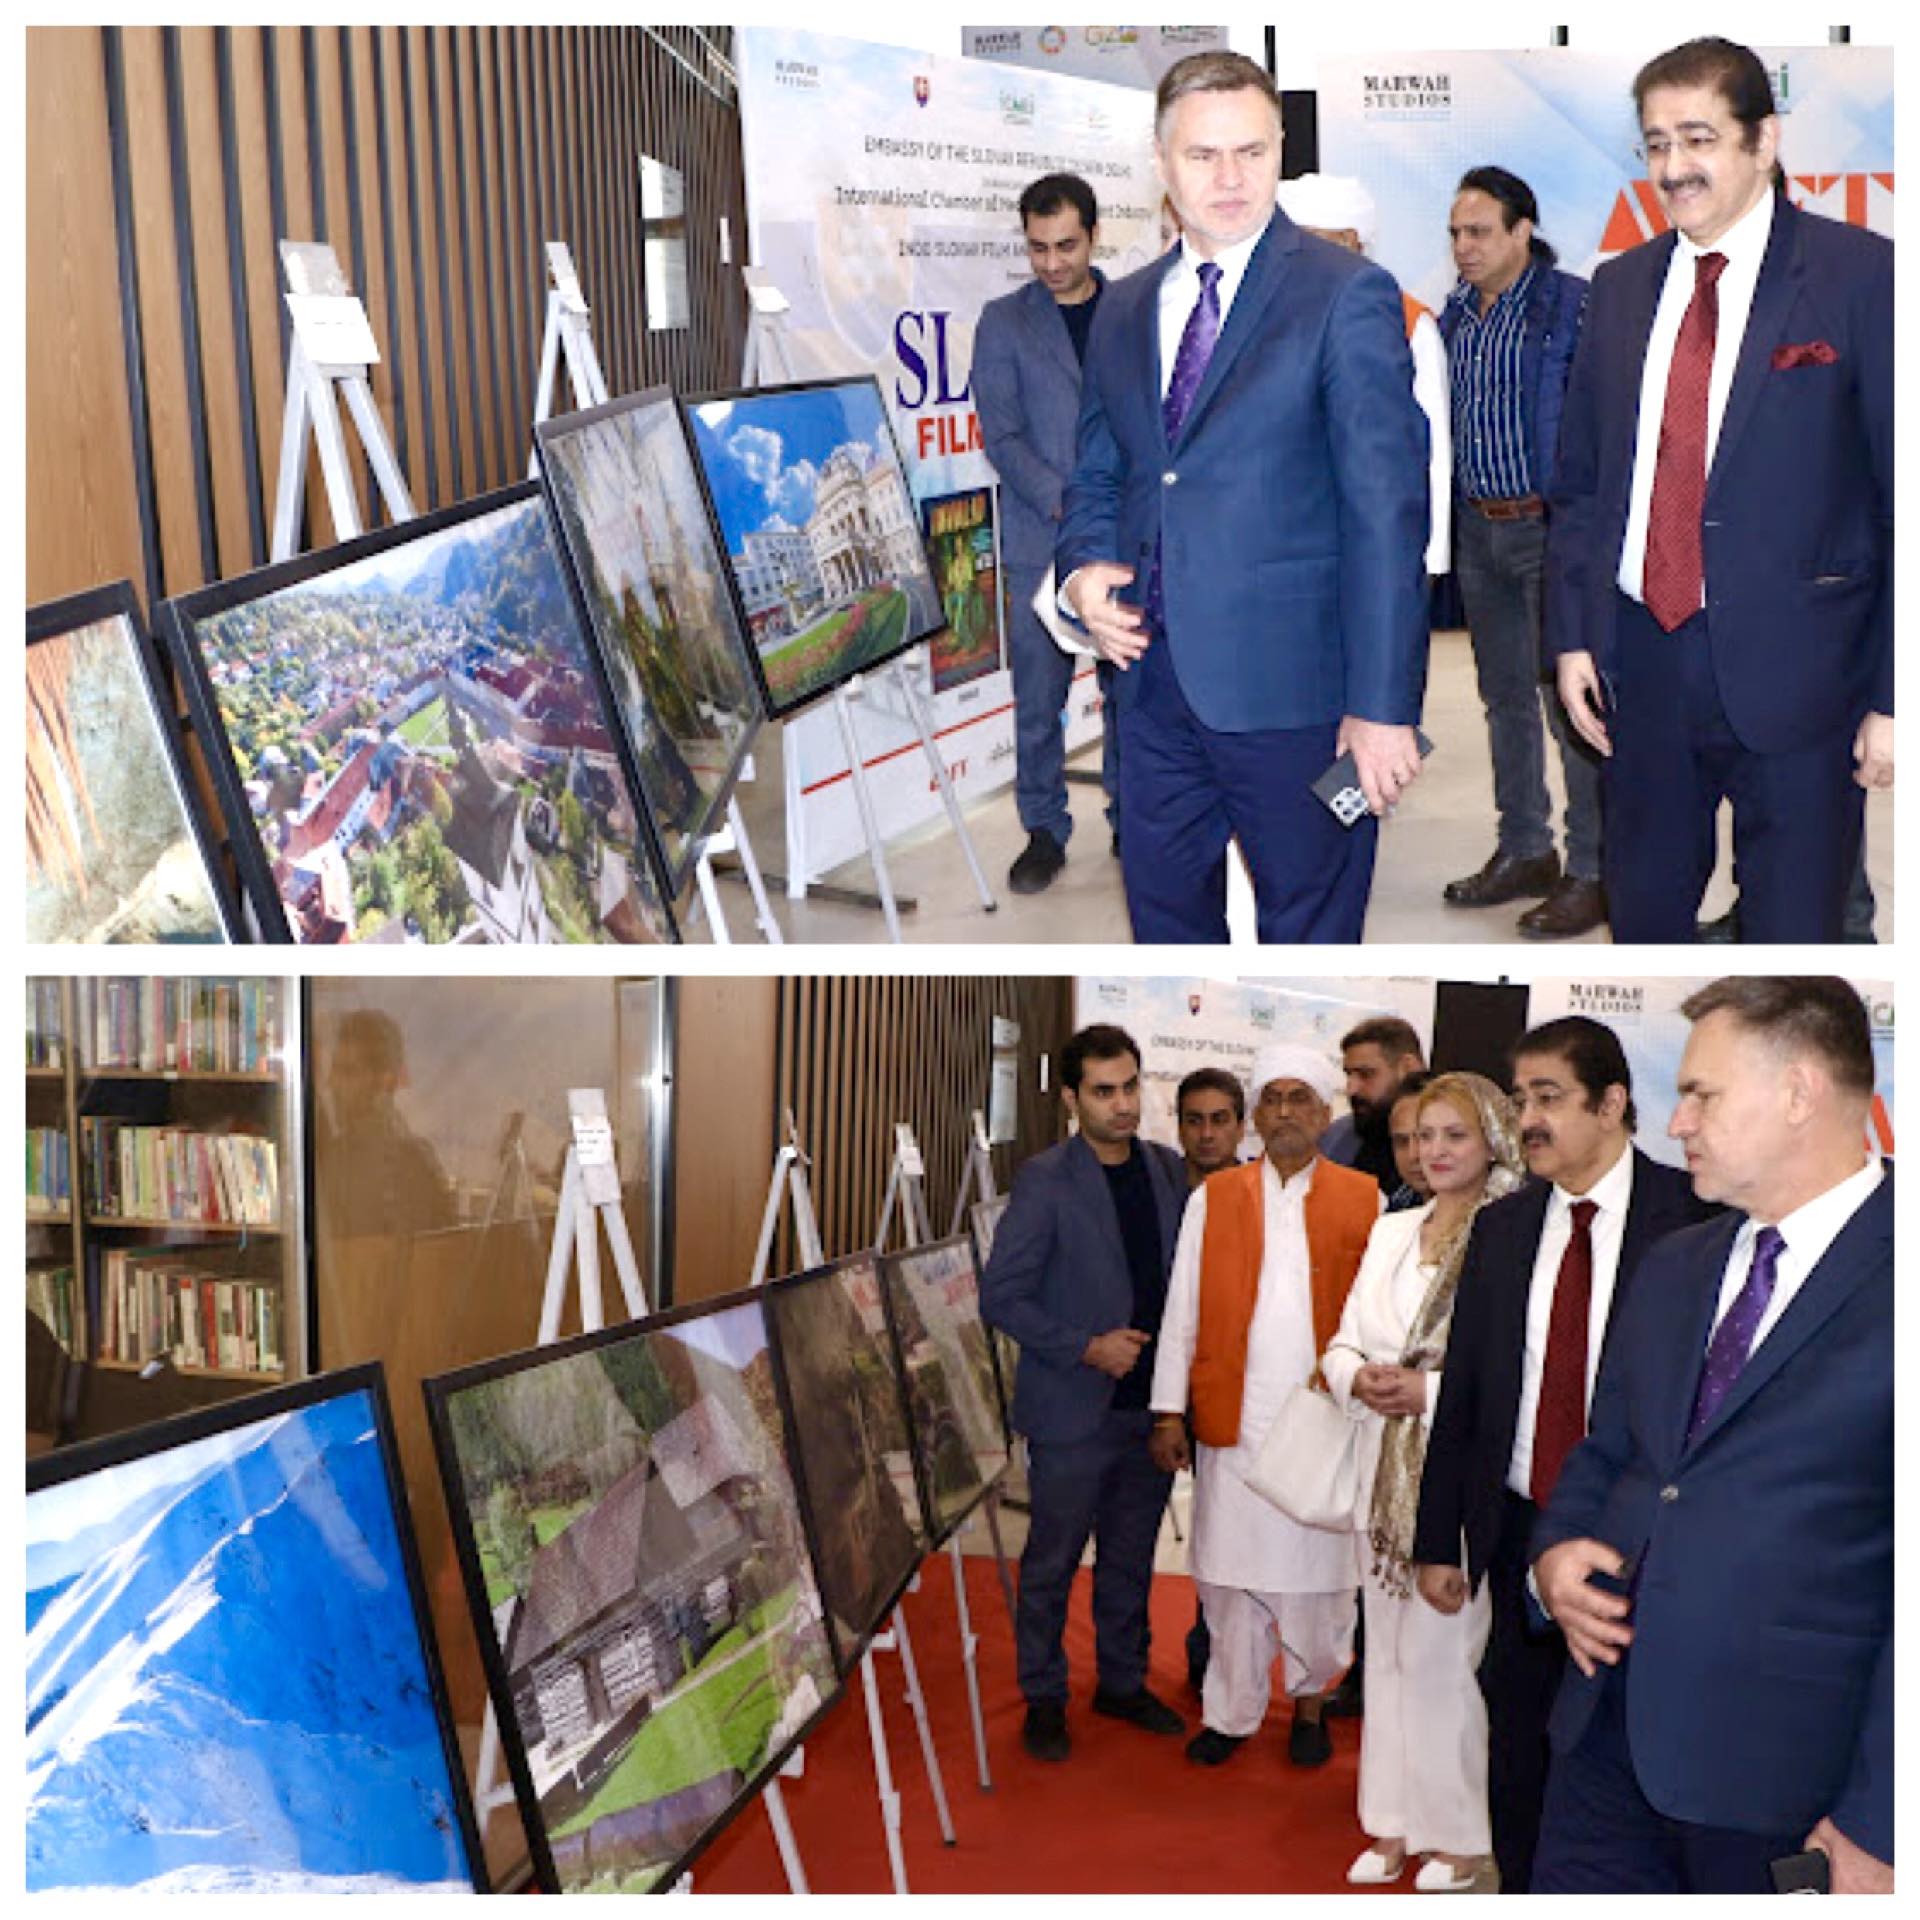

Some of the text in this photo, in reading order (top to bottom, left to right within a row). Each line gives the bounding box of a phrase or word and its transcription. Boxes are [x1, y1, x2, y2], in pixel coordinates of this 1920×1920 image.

[1363, 75, 1451, 91] MARWAH
[1363, 93, 1451, 108] STUDIOS
[864, 135, 923, 158] EMBASSY
[946, 144, 969, 164] THE
[835, 185, 928, 208] International
[931, 190, 982, 212] Chamber
[896, 311, 969, 409] SL
[1569, 984, 1644, 999] MARWAH
